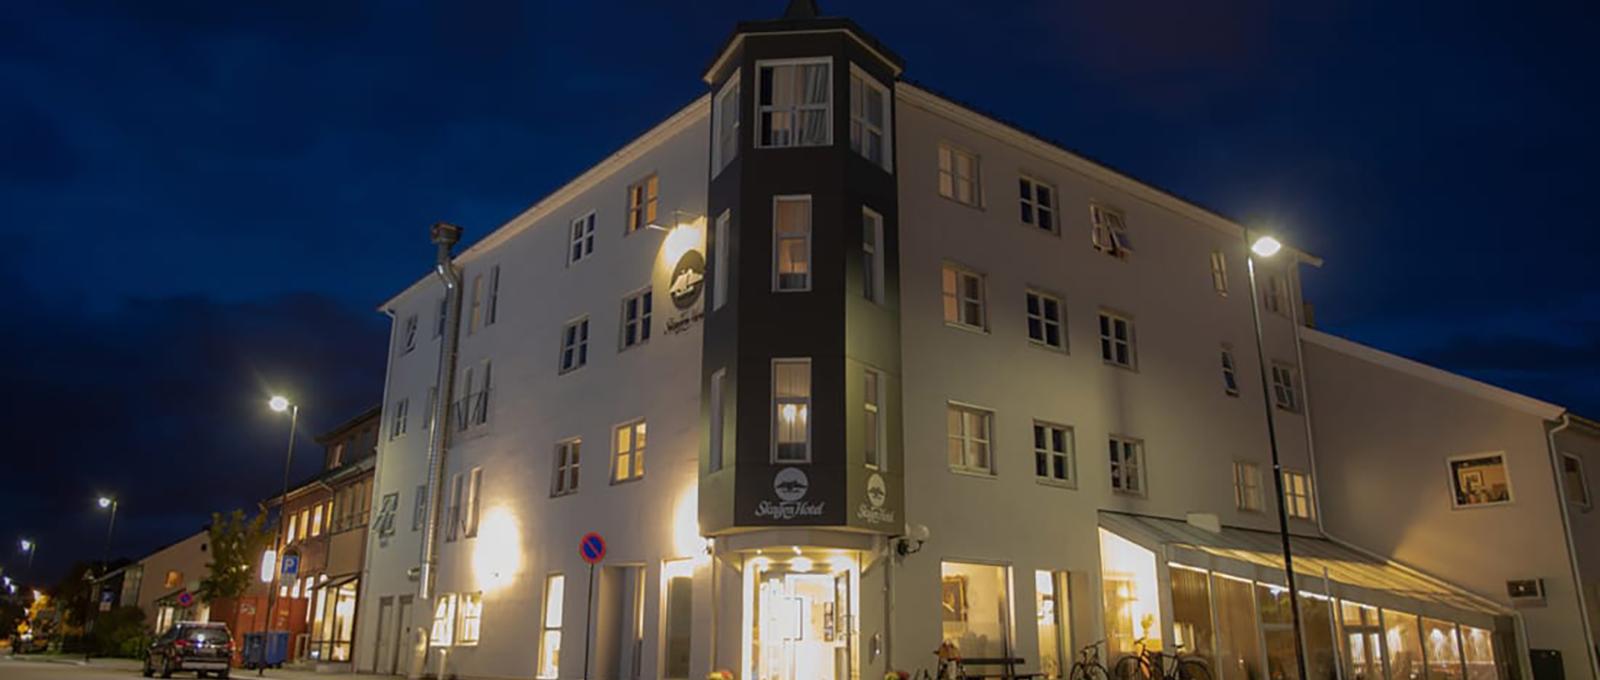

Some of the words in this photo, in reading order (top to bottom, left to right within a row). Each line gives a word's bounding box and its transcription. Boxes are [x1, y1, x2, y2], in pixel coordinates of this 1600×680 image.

[755, 500, 794, 519] Skagen
[792, 500, 825, 516] Hotel
[284, 559, 295, 573] P
